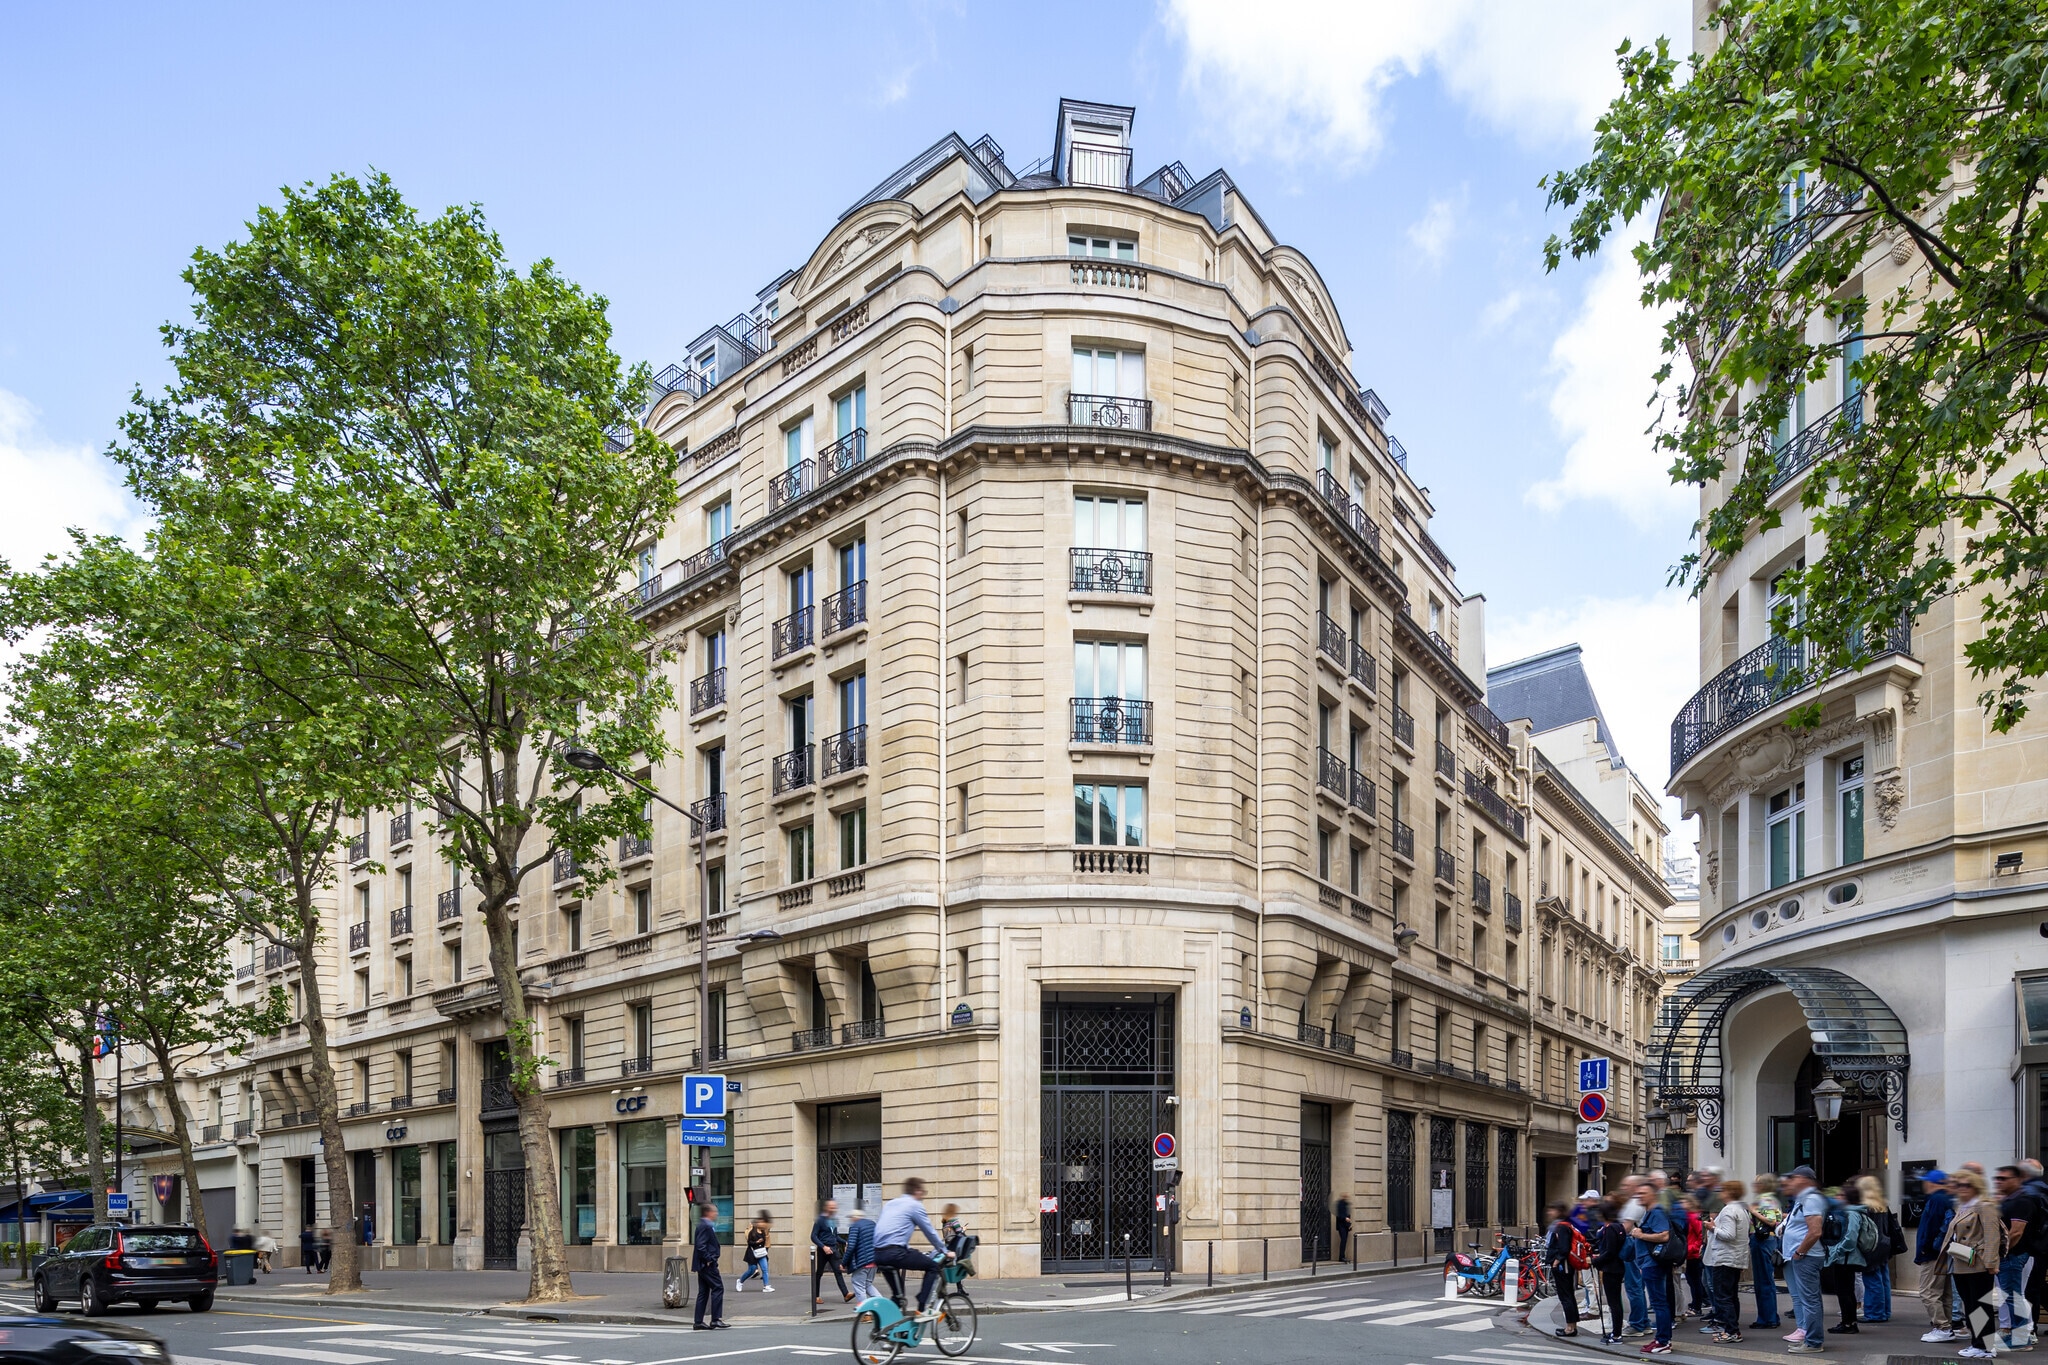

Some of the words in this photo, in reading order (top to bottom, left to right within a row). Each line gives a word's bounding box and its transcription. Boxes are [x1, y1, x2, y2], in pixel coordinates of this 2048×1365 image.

[616, 1096, 648, 1113] CCF
[696, 1084, 714, 1108] P
[386, 1127, 408, 1140] CCF
